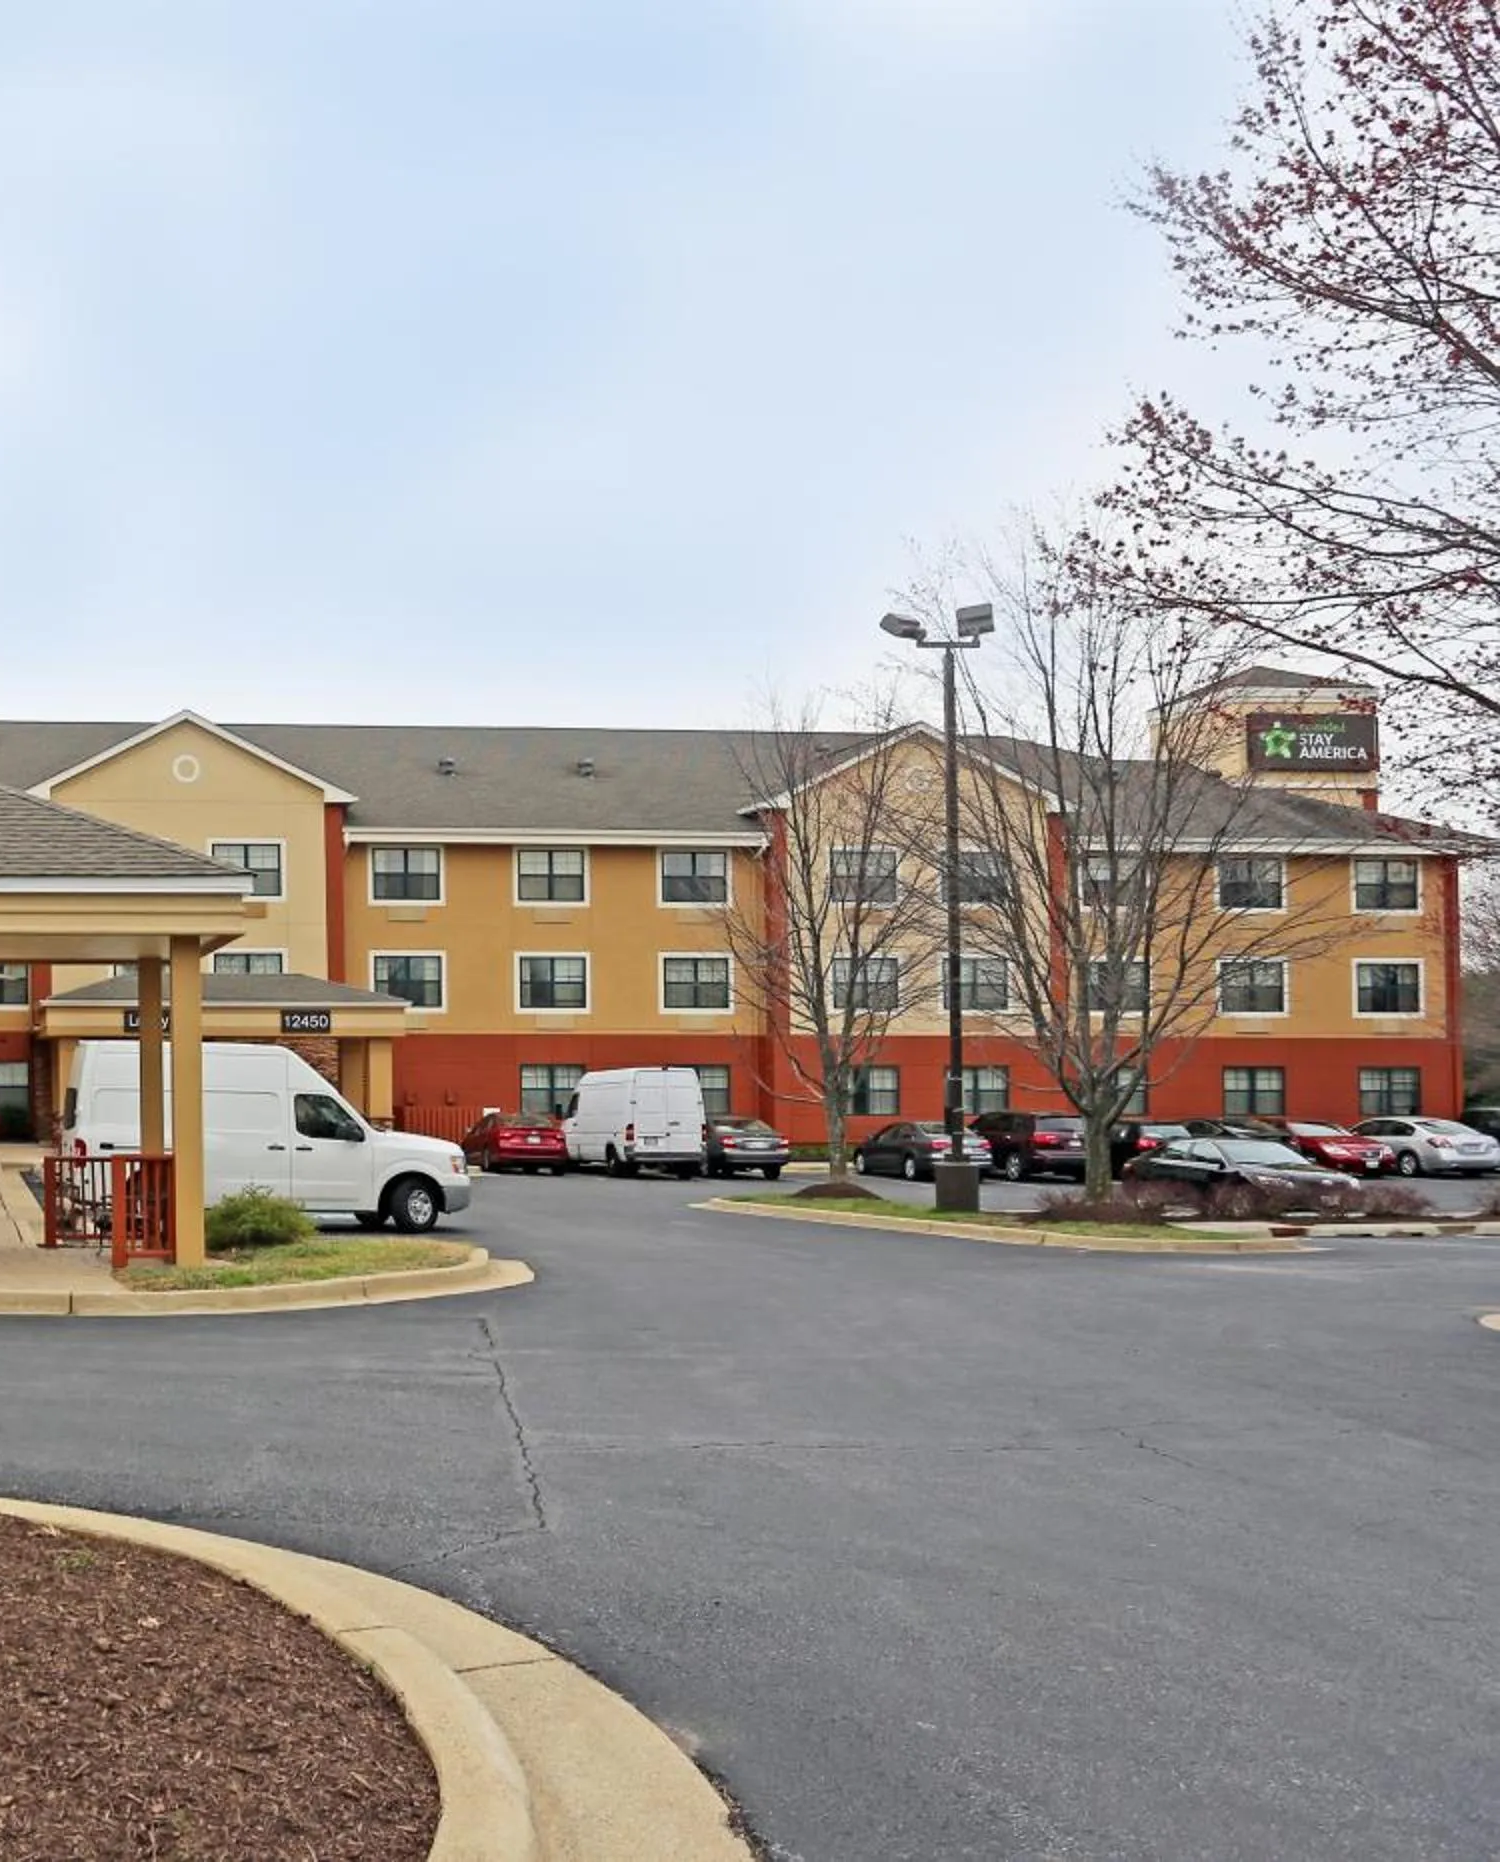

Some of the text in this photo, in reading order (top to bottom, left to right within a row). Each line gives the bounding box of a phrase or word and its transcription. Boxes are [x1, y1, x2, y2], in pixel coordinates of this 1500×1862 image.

[1299, 733, 1334, 745] STAY
[1299, 746, 1368, 760] AMERICA
[284, 1014, 329, 1029] 12450
